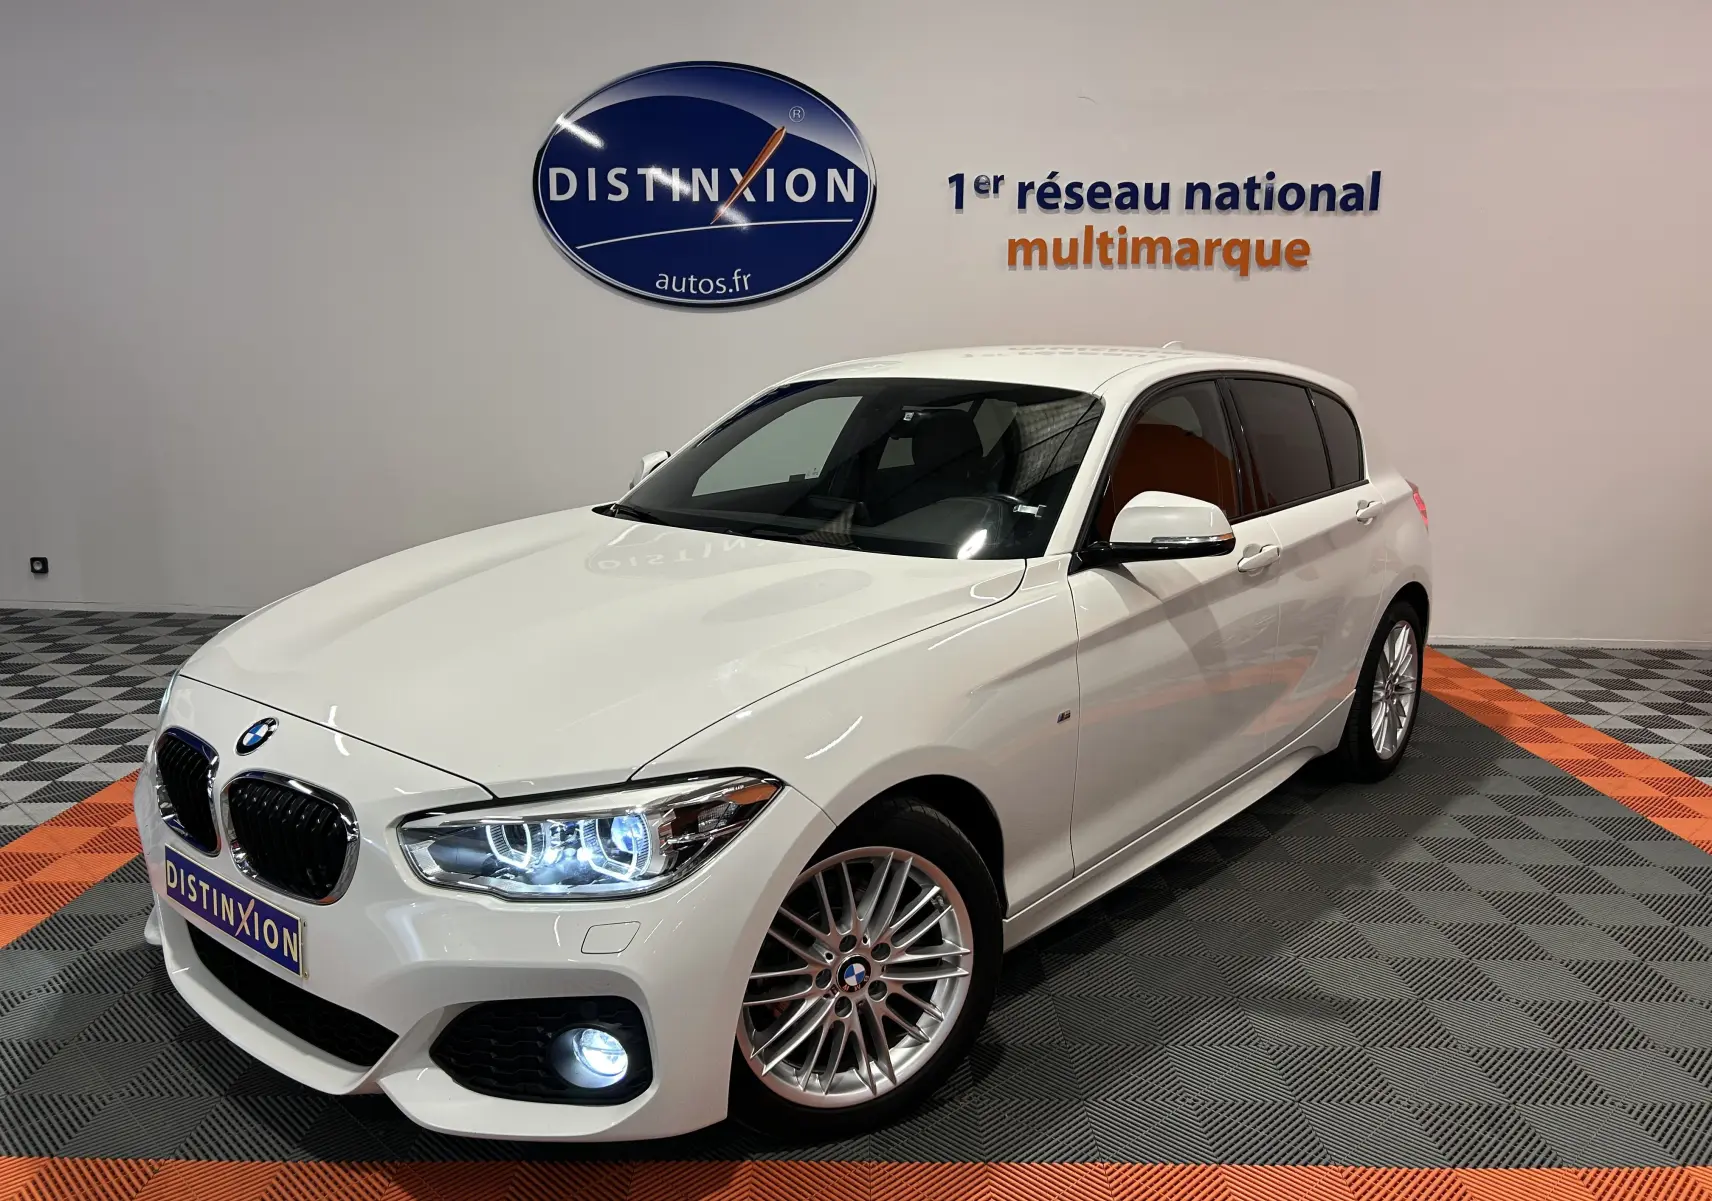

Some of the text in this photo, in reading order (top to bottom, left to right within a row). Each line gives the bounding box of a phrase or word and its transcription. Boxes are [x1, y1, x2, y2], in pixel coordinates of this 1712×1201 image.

[1017, 170, 1170, 212] réseau
[1184, 170, 1382, 213] national
[1007, 224, 1312, 277] multimarque
[655, 268, 752, 295] autos.fr
[165, 859, 299, 963] DISTINXION
